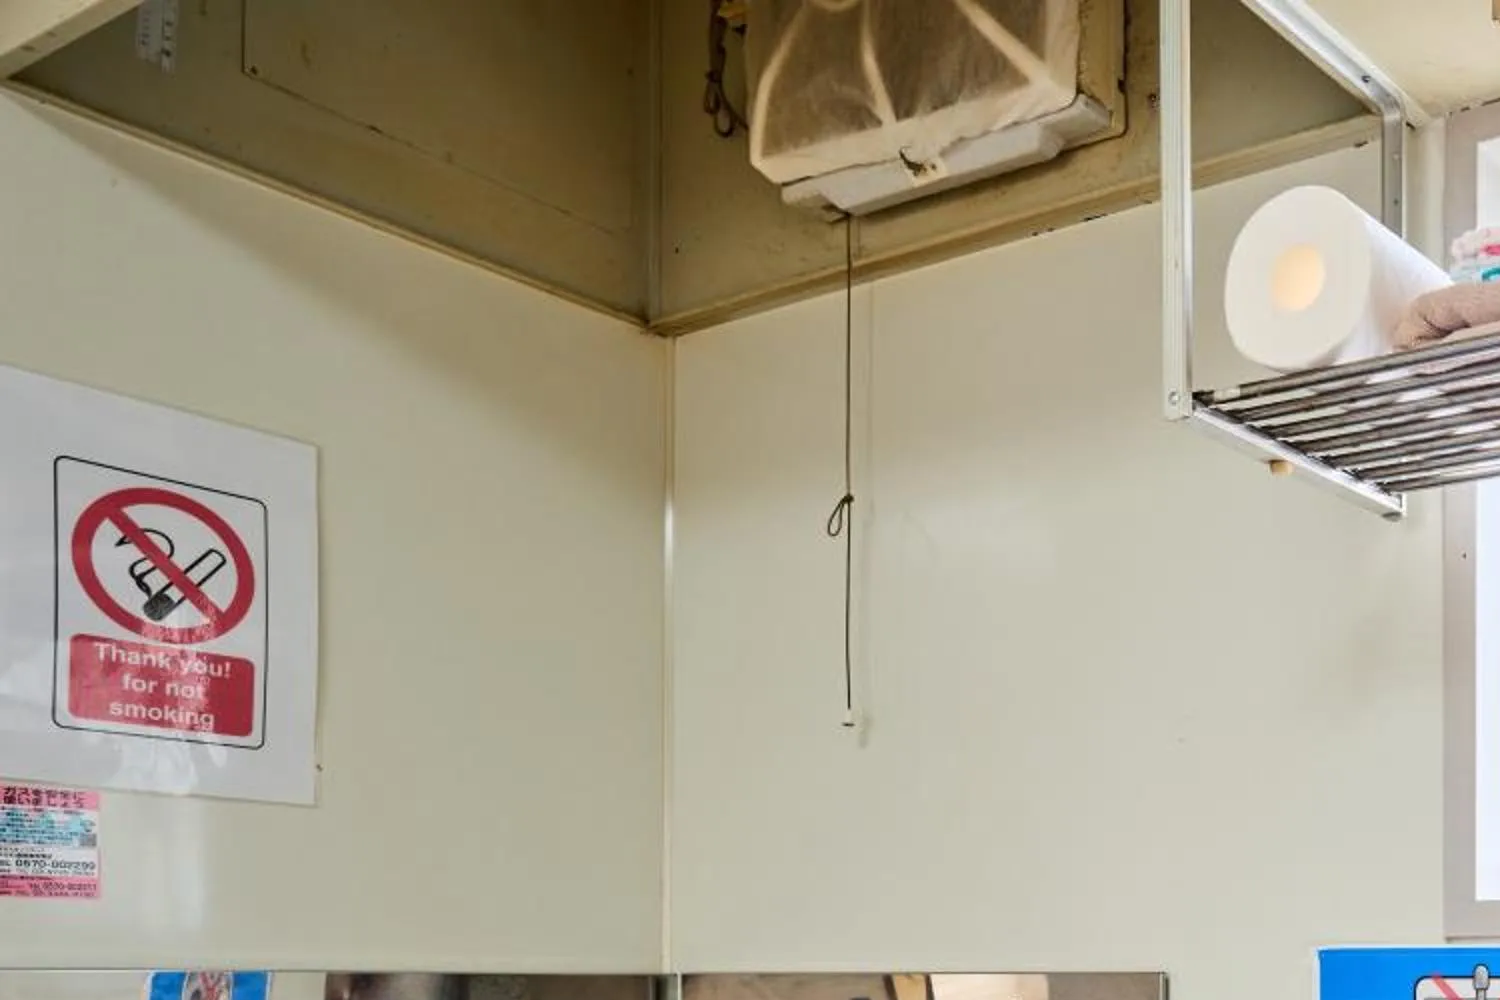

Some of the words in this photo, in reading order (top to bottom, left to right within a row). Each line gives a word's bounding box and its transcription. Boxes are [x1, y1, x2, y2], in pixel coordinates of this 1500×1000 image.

[94, 643, 173, 669] Thank
[180, 658, 231, 680] you!
[122, 672, 158, 694] for
[166, 682, 206, 700] not
[109, 701, 214, 731] smoking
